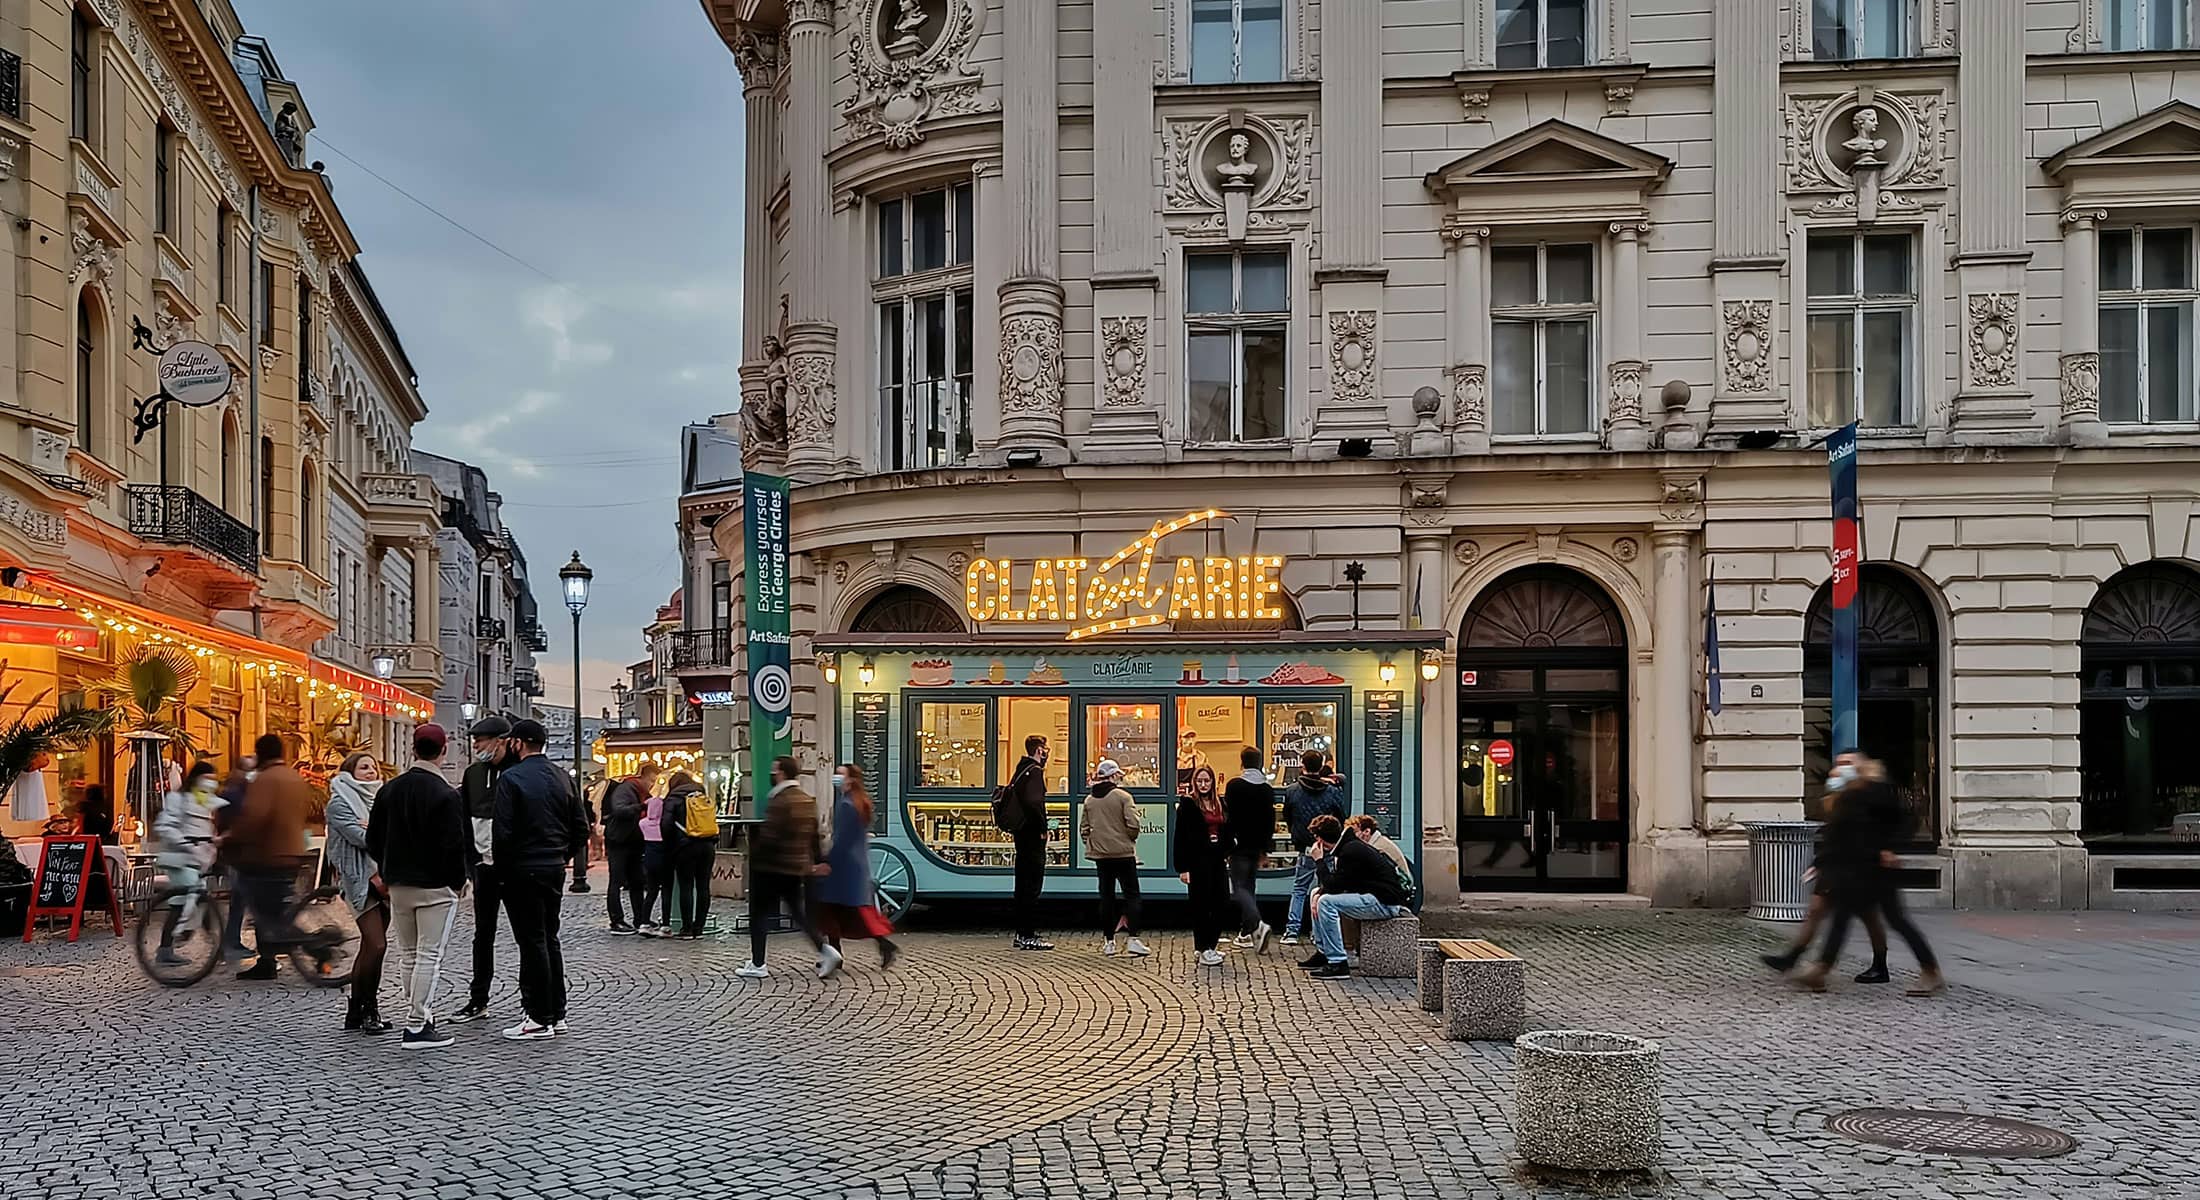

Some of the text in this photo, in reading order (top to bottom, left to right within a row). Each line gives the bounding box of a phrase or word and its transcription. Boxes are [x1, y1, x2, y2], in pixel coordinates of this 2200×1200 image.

[161, 362, 219, 379] Bucharest
[769, 490, 782, 540] Circles
[754, 487, 771, 613] Express yourself
[1832, 548, 1840, 566] 6
[771, 543, 785, 596] George
[749, 629, 790, 644] Art Safar
[1272, 722, 1328, 737] Collect your
